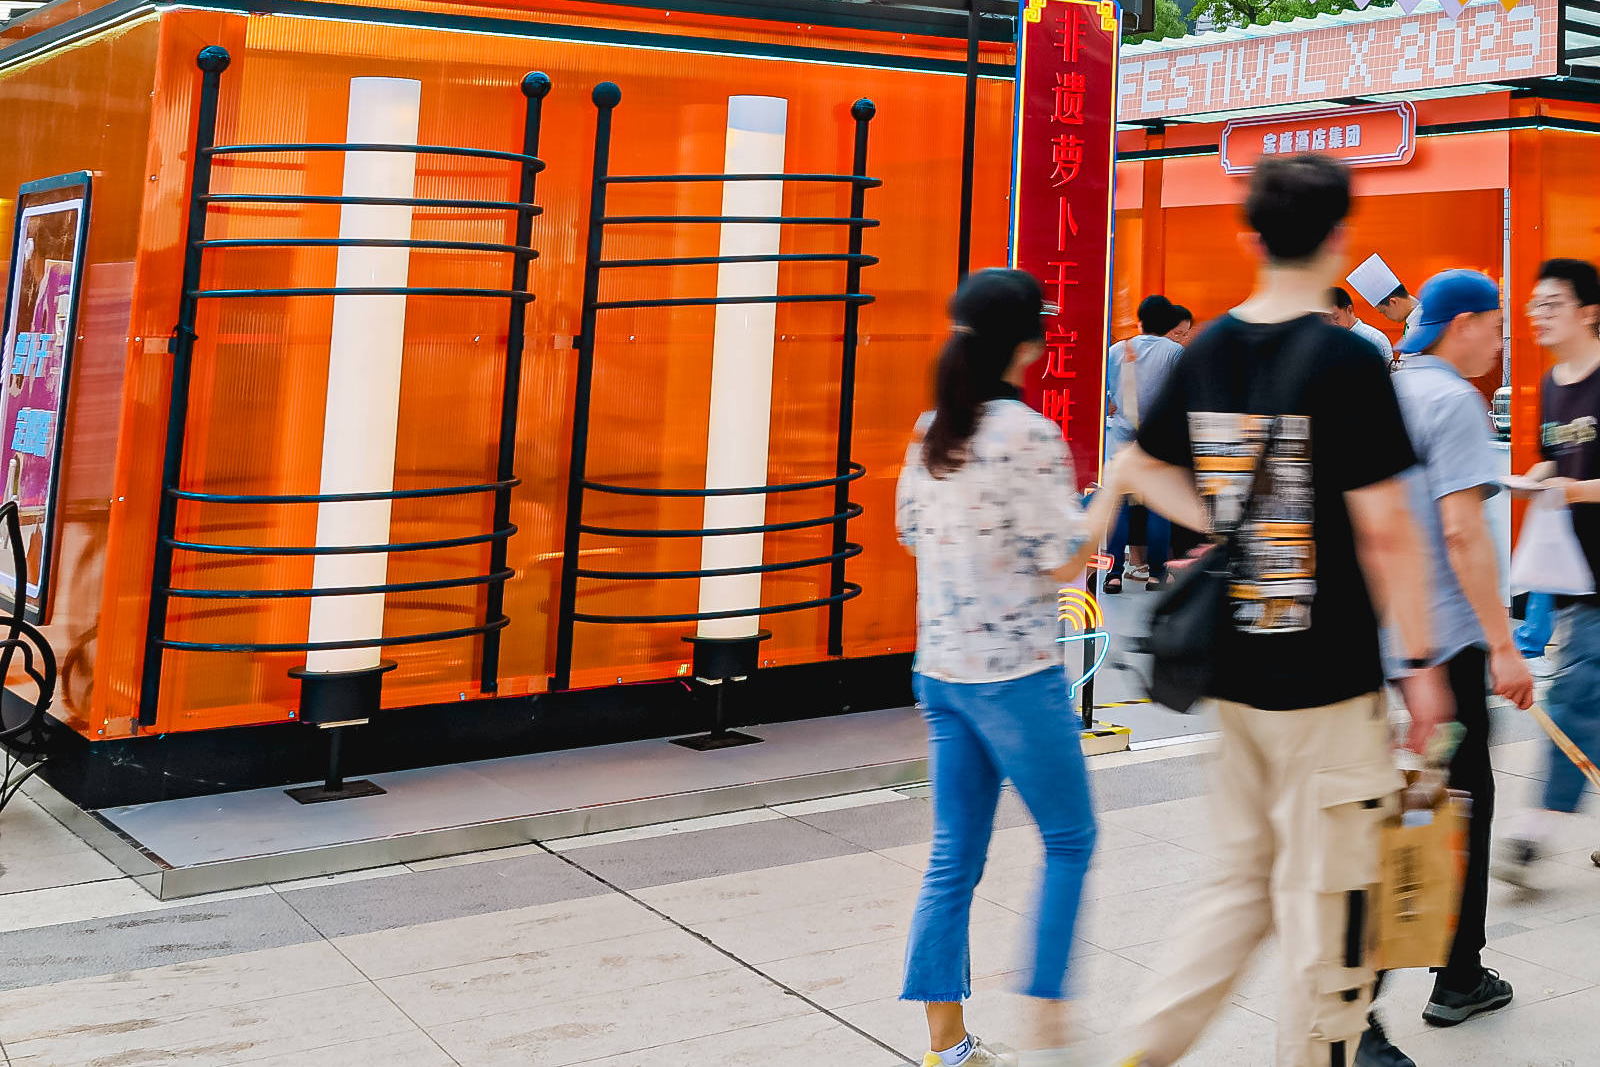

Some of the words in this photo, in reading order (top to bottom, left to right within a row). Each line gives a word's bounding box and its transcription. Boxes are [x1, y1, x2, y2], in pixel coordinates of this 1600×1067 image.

[1118, 36, 1326, 116] FESTIVAL
[1342, 27, 1375, 90] X
[1392, 4, 1540, 86] 2023
[1262, 124, 1361, 155] 宝盛酒店集团
